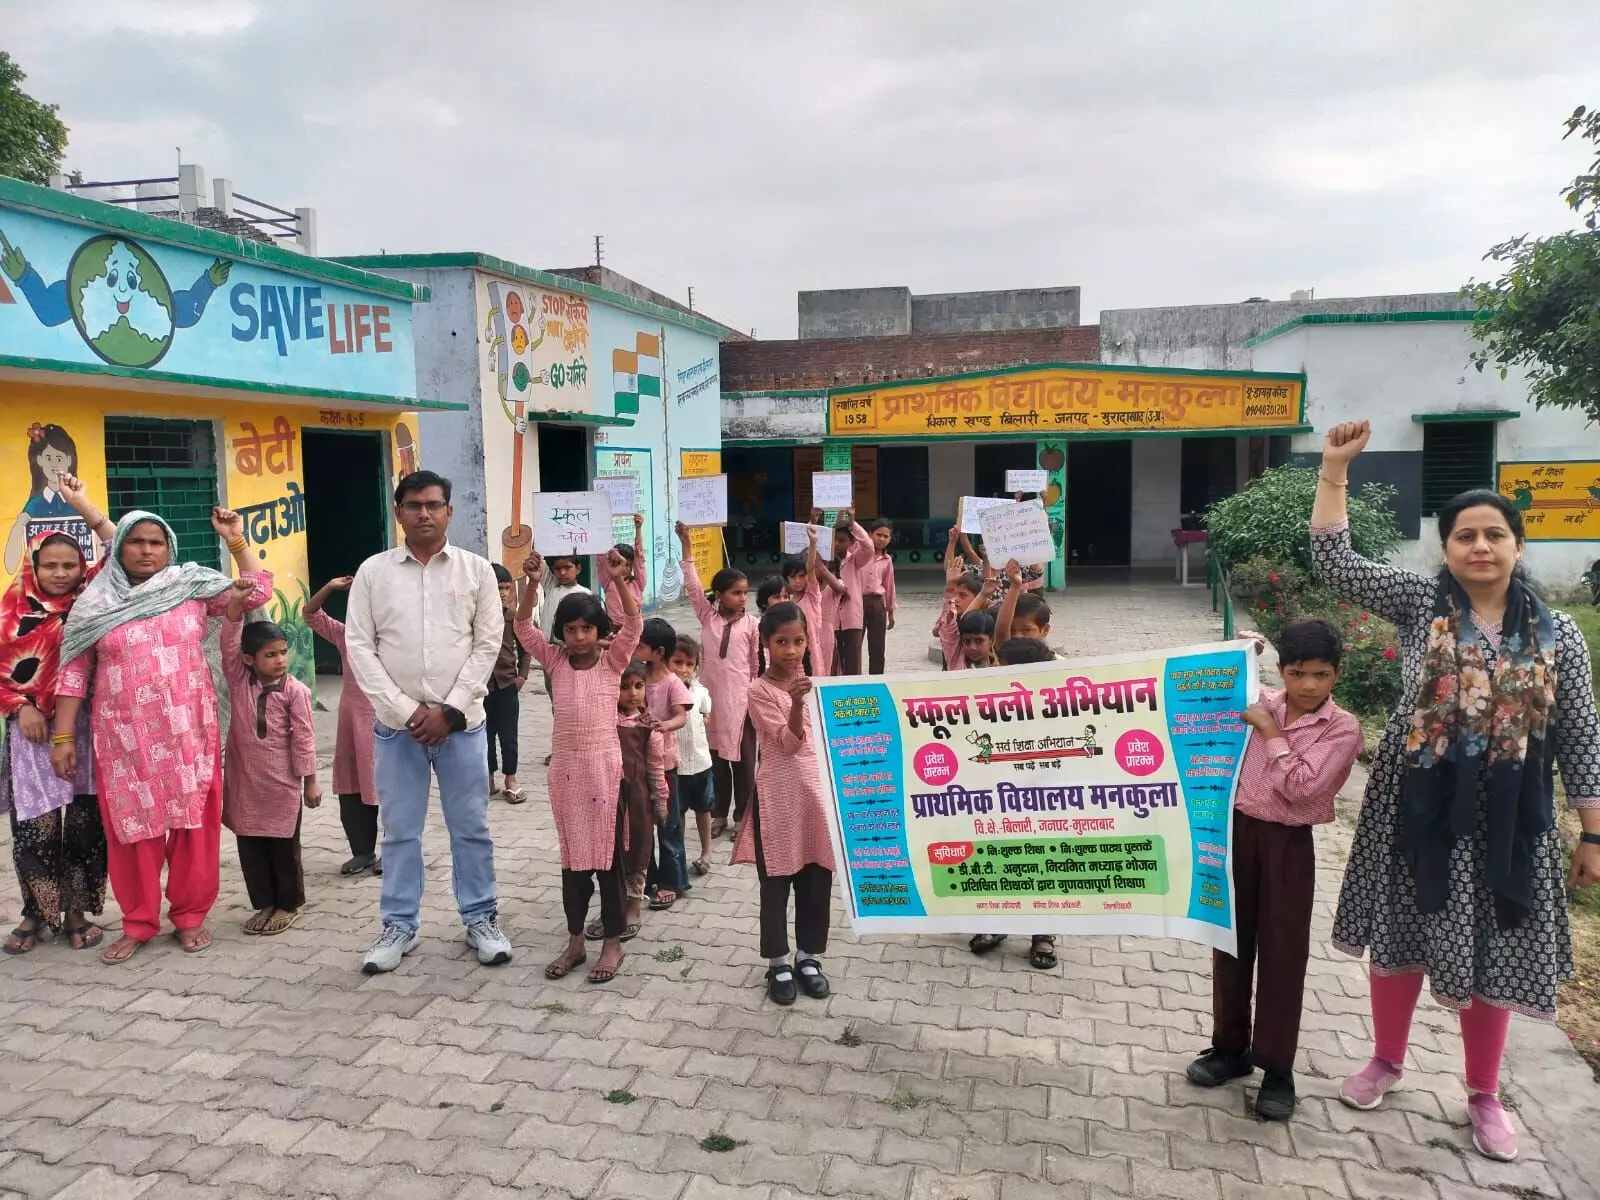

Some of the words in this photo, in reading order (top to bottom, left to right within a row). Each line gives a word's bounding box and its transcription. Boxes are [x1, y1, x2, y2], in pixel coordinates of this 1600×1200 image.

[542, 294, 566, 316] STOP
[230, 282, 324, 356] SAVE
[327, 304, 392, 354] LIFE
[550, 362, 566, 389] GO
[881, 384, 983, 421] प्राथमिक
[986, 376, 1102, 411] विद्यालय
[845, 413, 867, 425] 1958
[926, 413, 957, 428] विकास
[964, 415, 992, 429] खण्ड
[999, 410, 1040, 427] बिलारी
[1055, 412, 1090, 426] जनपद
[233, 416, 296, 477] बेटी
[903, 695, 970, 740] स्कूल
[974, 681, 1035, 723] चलो
[1040, 676, 1158, 718] अभियान
[995, 739, 1011, 752] सर्व
[1013, 738, 1035, 752] शिक्षा
[1037, 736, 1075, 750] अभियान
[1126, 737, 1149, 754] प्रवेश
[924, 751, 945, 766] प्रवेश
[1125, 755, 1154, 768] प्रारम्भ
[923, 766, 950, 779] प्रारम्भ
[911, 784, 993, 819] प्राथमिक
[997, 782, 1084, 813] विद्यालय
[1088, 782, 1178, 818] मनकुला
[1024, 843, 1046, 856] शिक्षा
[1046, 858, 1086, 873] नियमित
[1126, 856, 1158, 872] भोजन
[1037, 878, 1056, 892] द्वारा
[1058, 874, 1111, 894] गुणवत्तापूर्ण
[1114, 874, 1146, 889] शिक्षण
